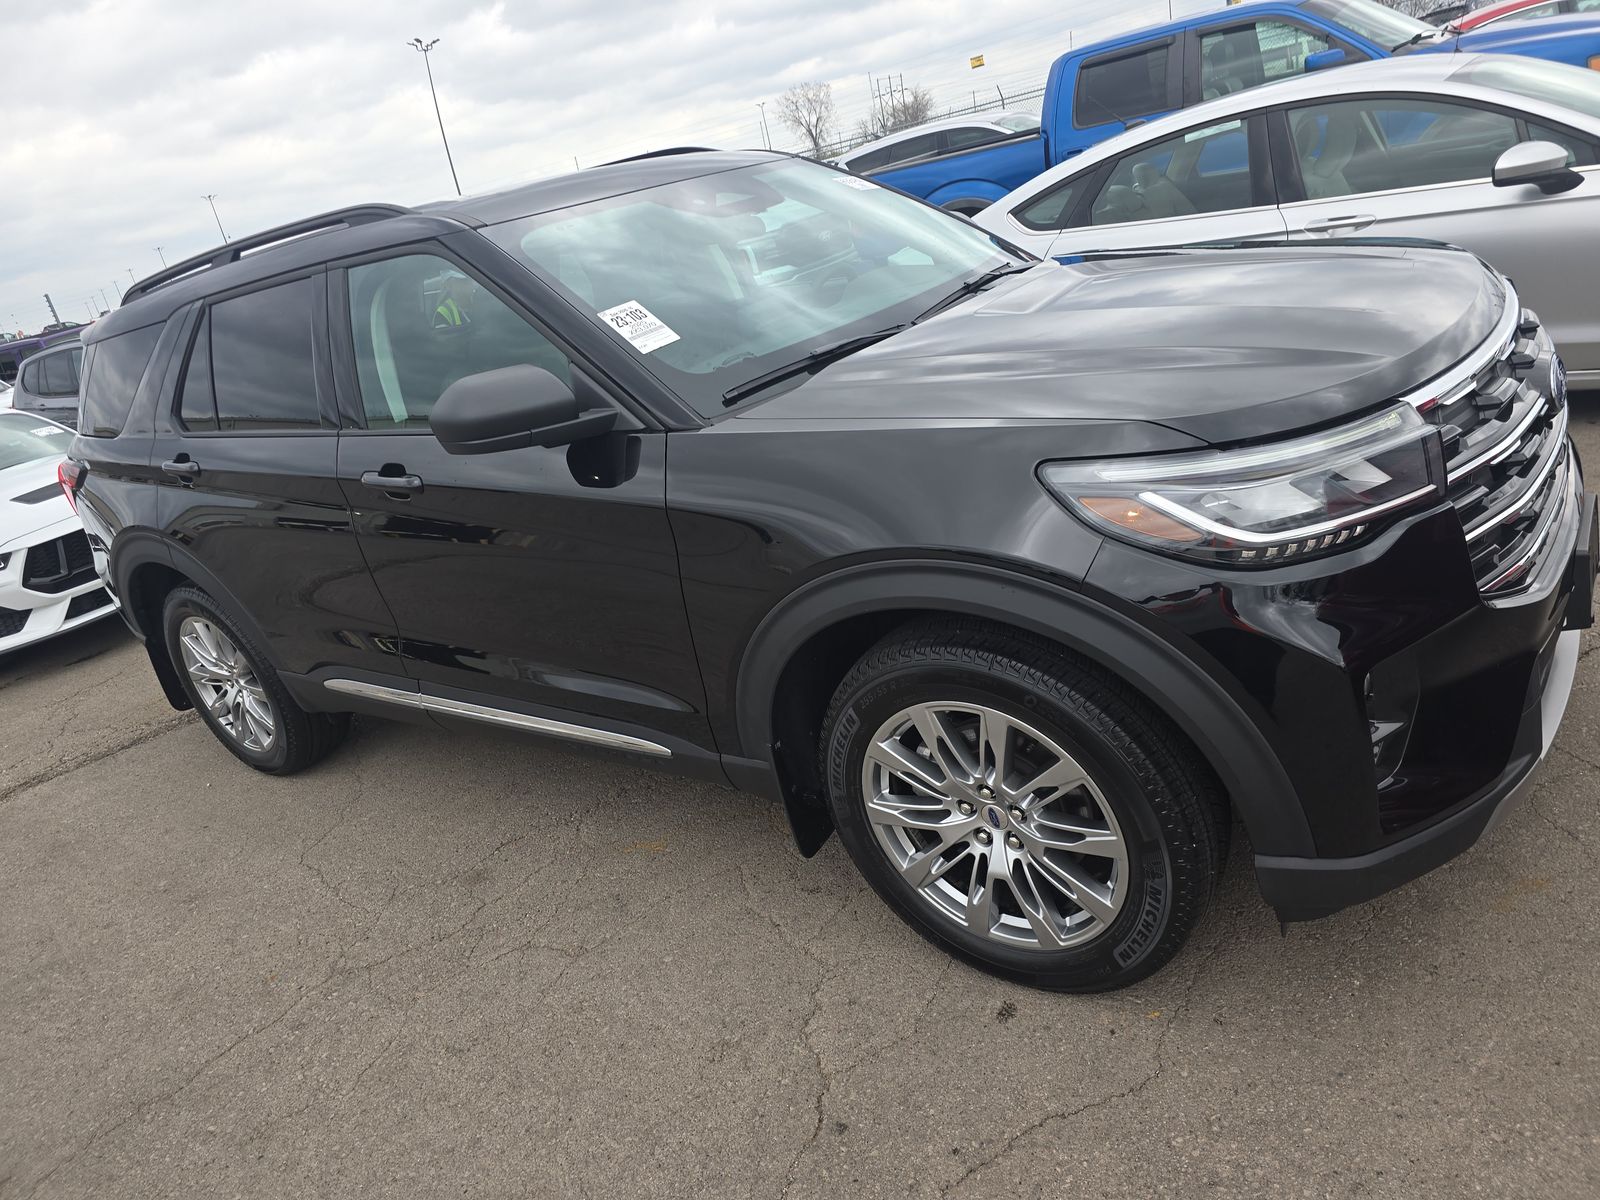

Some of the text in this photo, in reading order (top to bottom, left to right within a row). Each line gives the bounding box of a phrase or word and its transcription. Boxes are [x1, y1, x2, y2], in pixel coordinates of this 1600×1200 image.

[610, 308, 648, 329] 23:103
[832, 713, 858, 792] MICHELIN
[1118, 883, 1163, 964] MICHELIN
